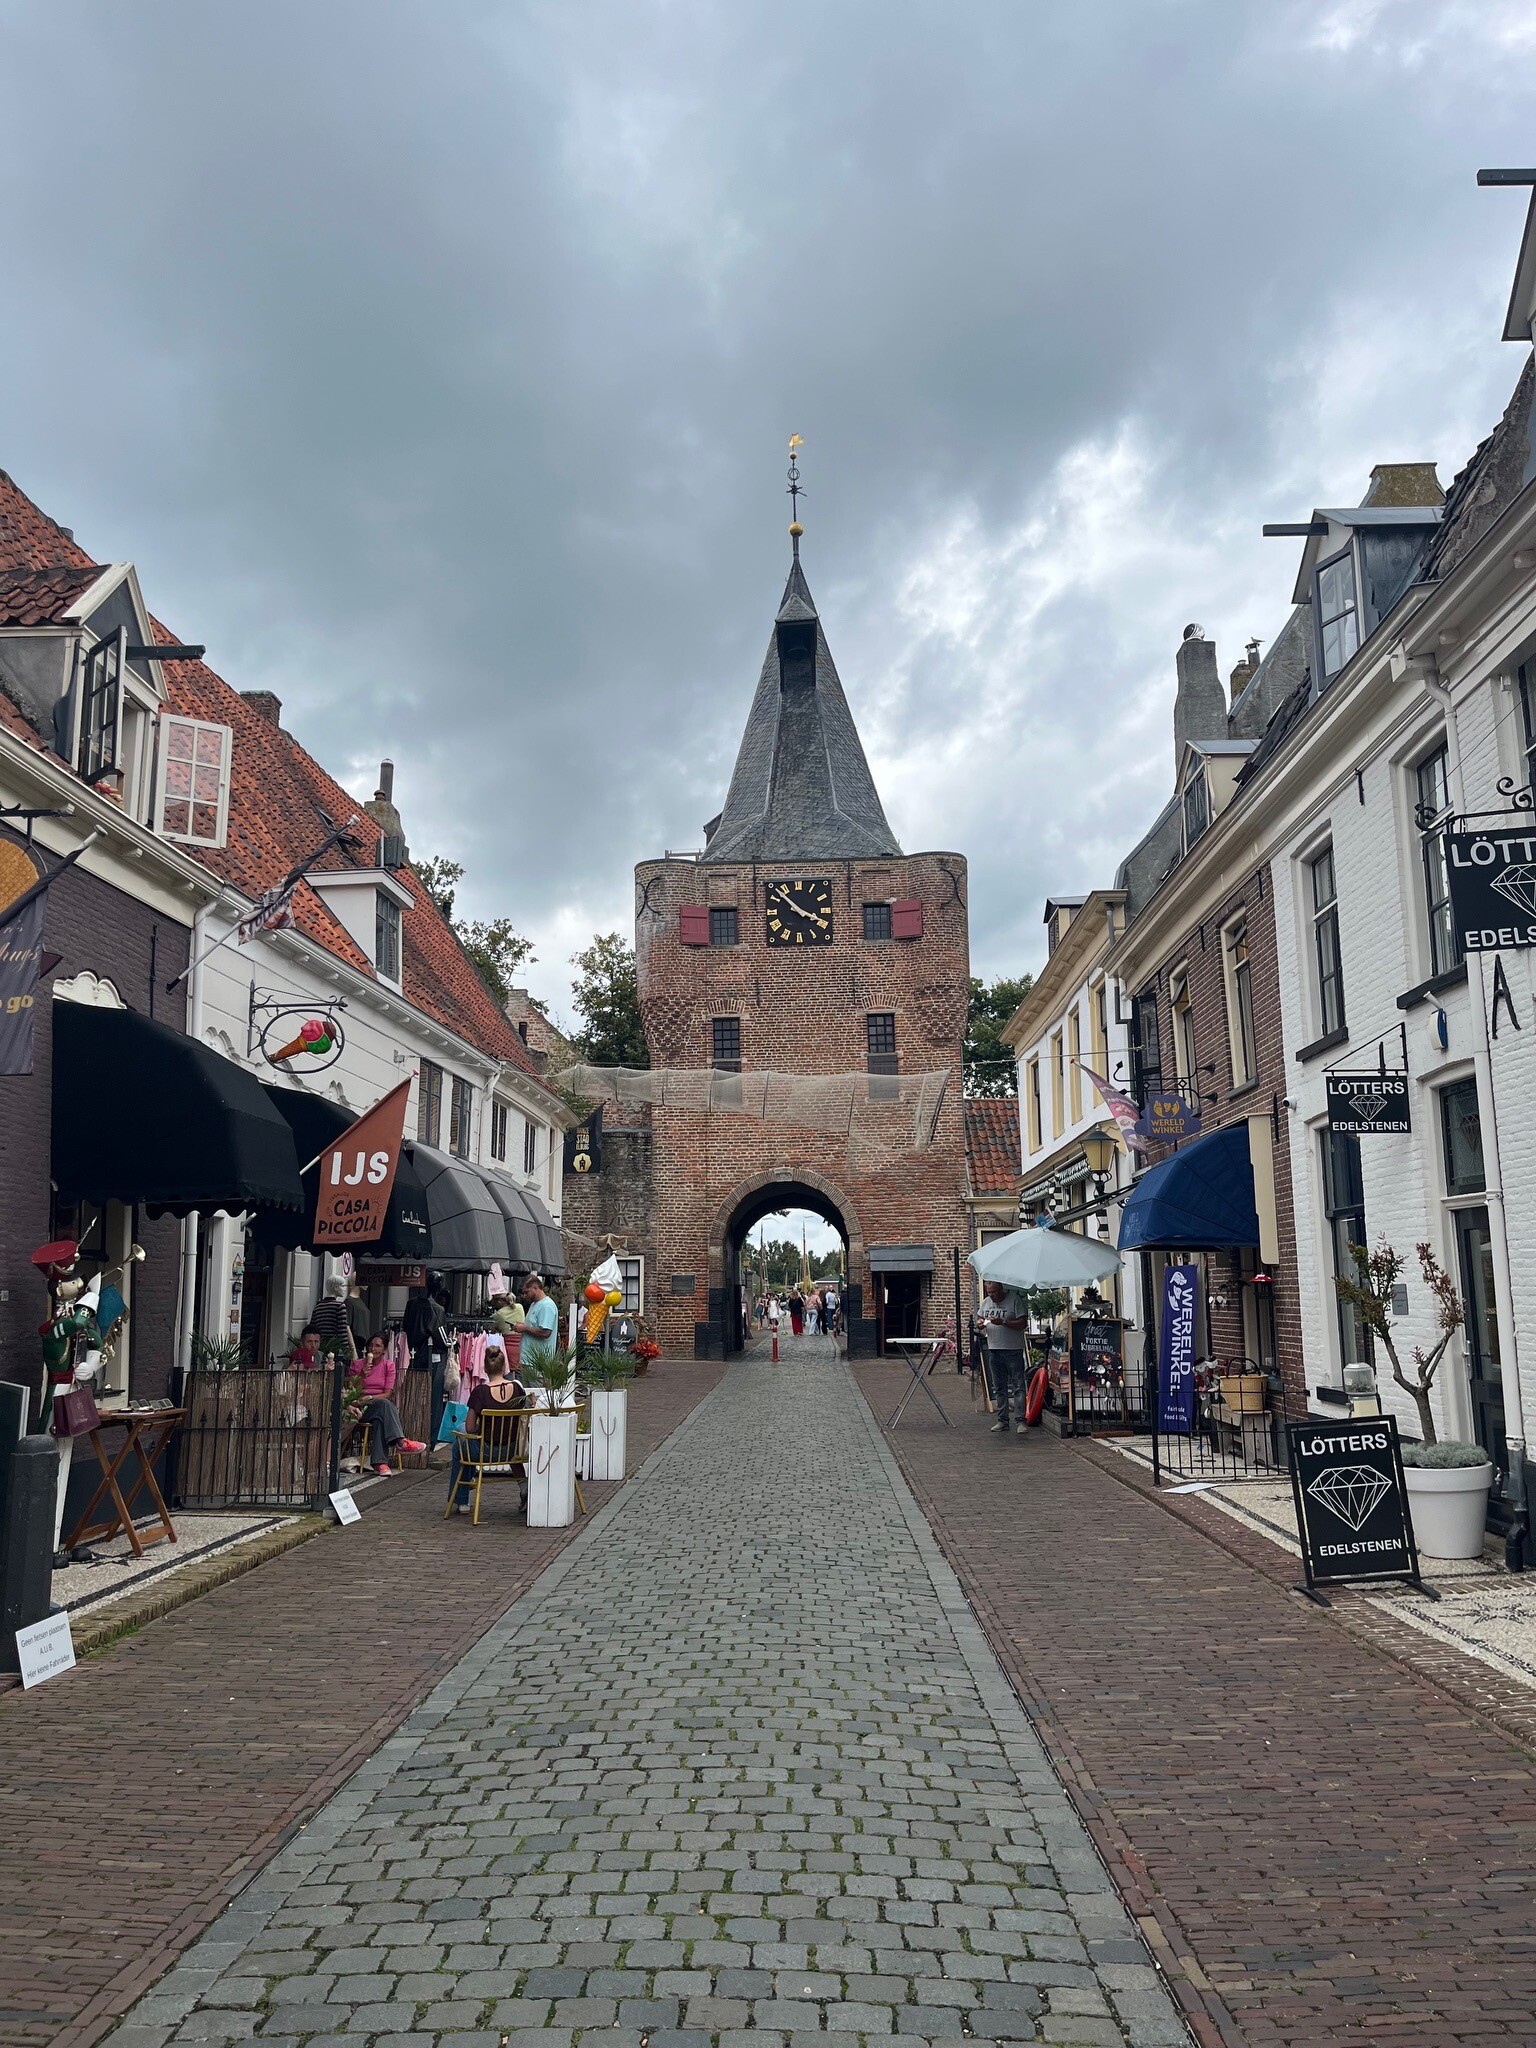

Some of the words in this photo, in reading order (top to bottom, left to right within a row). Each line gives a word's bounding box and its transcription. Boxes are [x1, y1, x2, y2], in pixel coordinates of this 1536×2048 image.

[6, 995, 34, 1013] go
[1328, 1079, 1405, 1095] LÖTTERS
[1152, 1126, 1185, 1134] WINKEL
[1332, 1121, 1408, 1131] EDELSTENEN
[330, 1151, 389, 1185] IJS
[334, 1198, 370, 1217] CASA
[318, 1216, 377, 1235] PICCOLA
[400, 1266, 421, 1278] IJS
[1180, 1287, 1193, 1376] WERELD
[1170, 1317, 1182, 1397] WINKEL
[1300, 1433, 1388, 1456] LÖTTERS
[1319, 1538, 1402, 1557] EDELSTENEN
[20, 1637, 33, 1648] Geen
[27, 1669, 37, 1679] Hier
